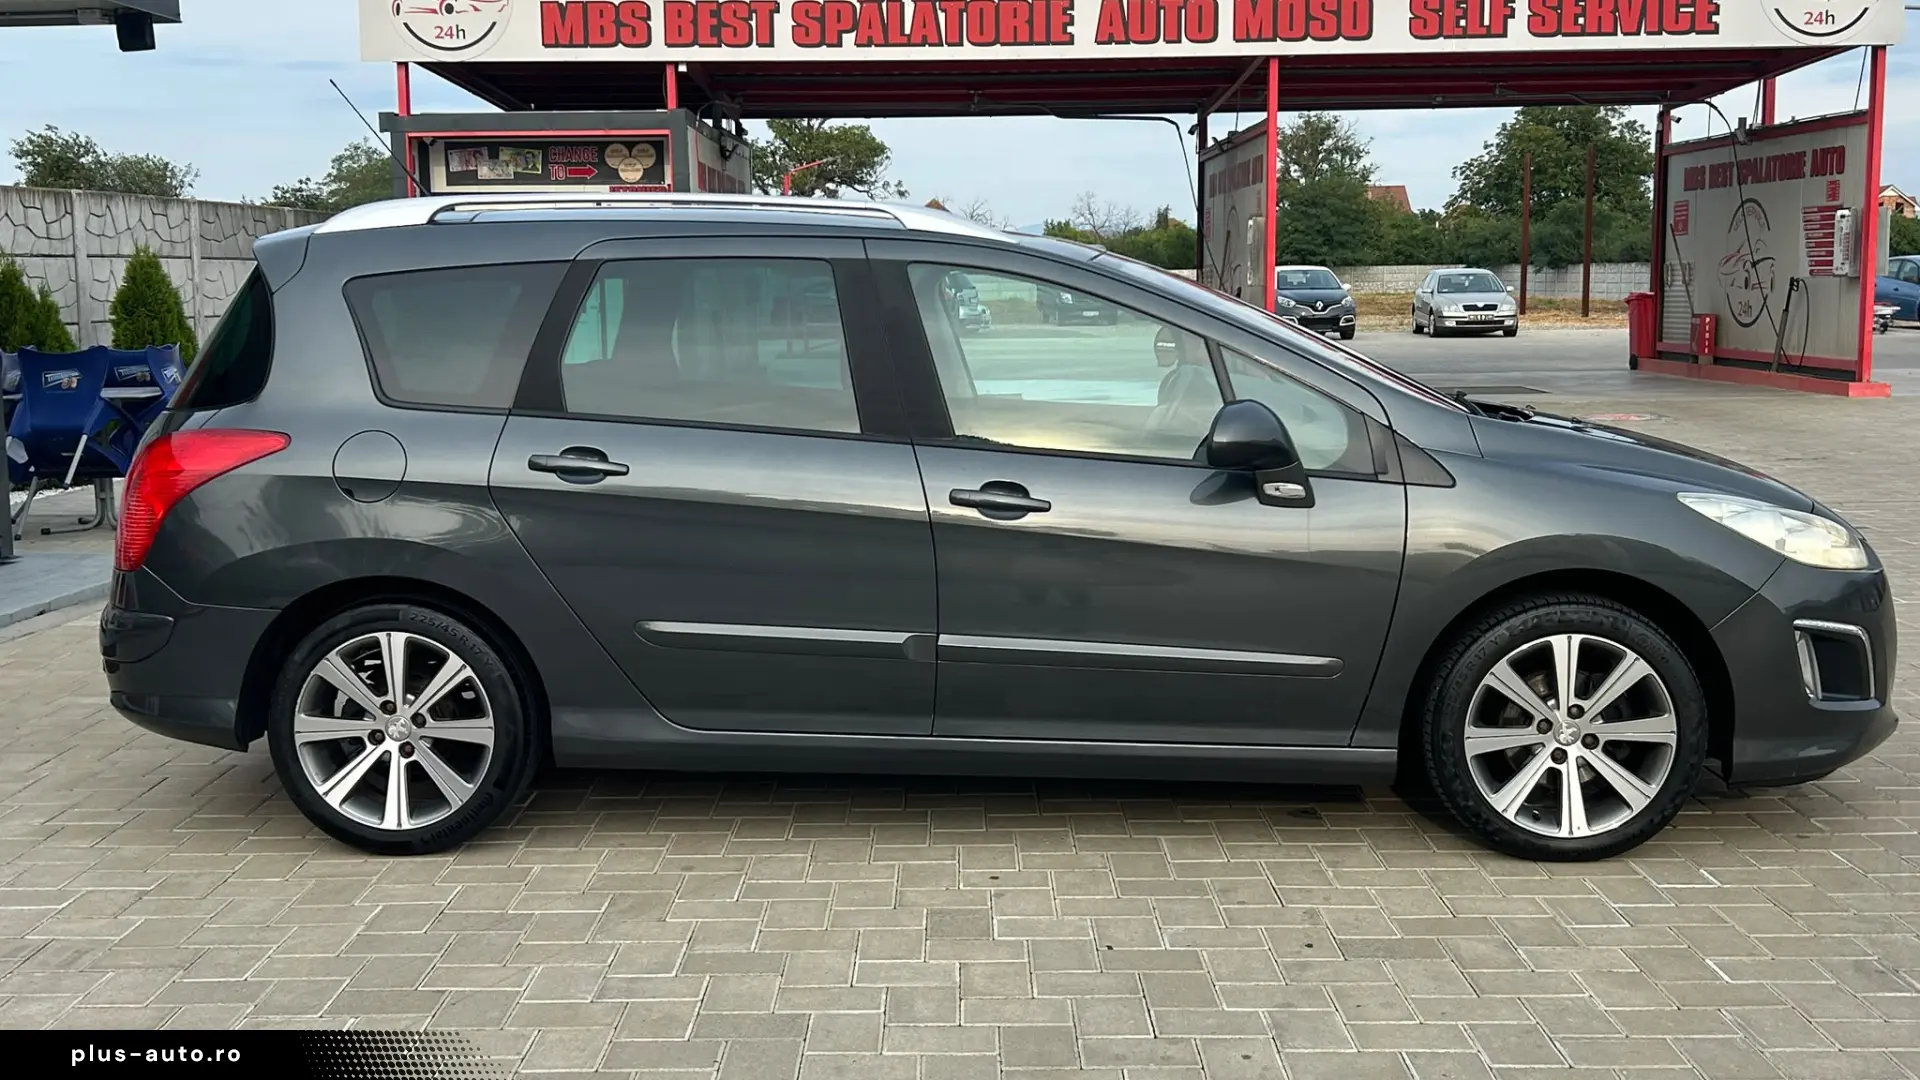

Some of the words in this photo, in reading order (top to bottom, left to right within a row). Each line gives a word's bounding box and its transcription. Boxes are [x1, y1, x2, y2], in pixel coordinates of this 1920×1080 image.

[540, 0, 652, 48] MBS
[664, 0, 780, 48] BEST
[791, 0, 1075, 47] SPALATORIE
[1094, 0, 1219, 45] AUTO
[1233, 0, 1373, 42] MOSO
[1409, 0, 1516, 39] SELF
[1527, 0, 1721, 36] SERVICE
[1803, 9, 1835, 25] 24h
[434, 25, 467, 40] 24h
[548, 146, 599, 163] CHANGE
[1810, 145, 1846, 178] AUTO
[548, 164, 566, 180] TO
